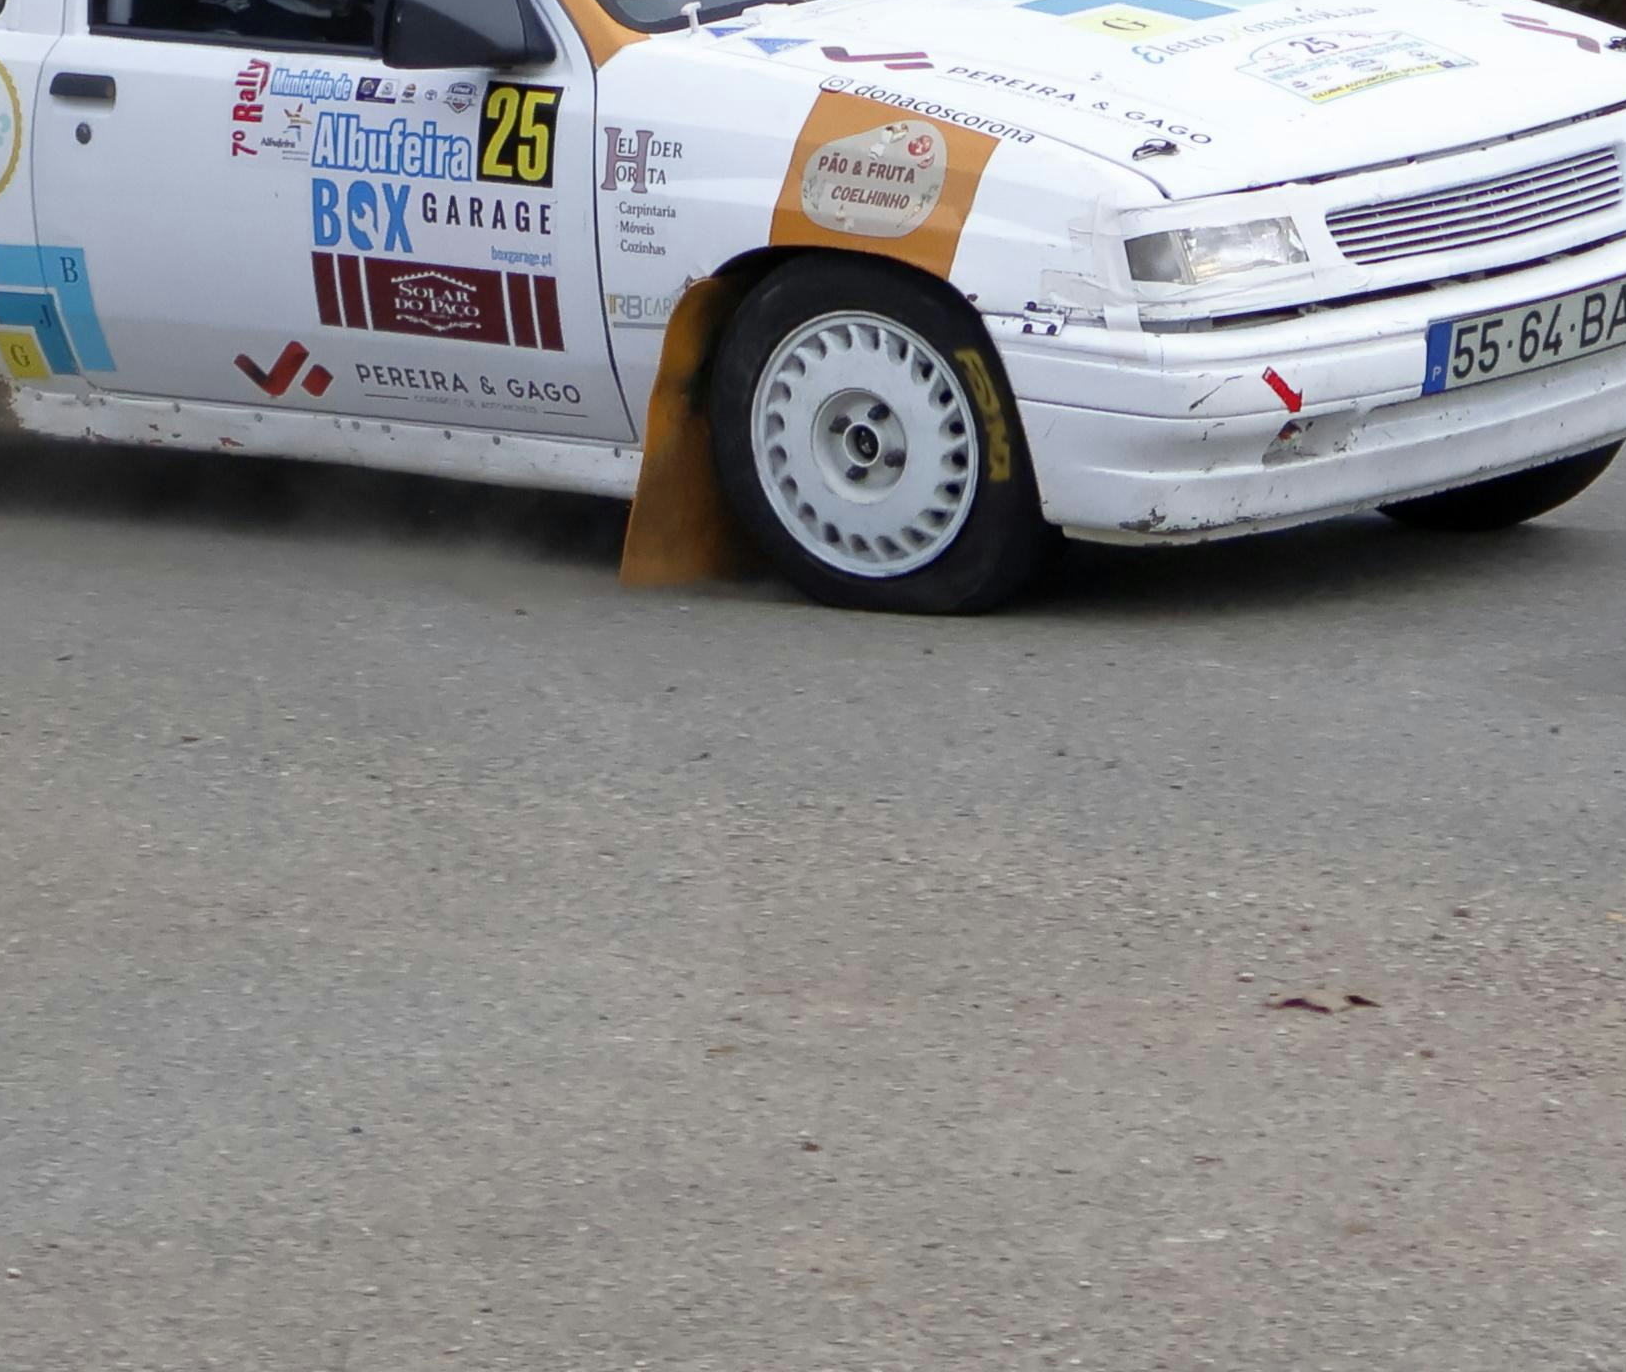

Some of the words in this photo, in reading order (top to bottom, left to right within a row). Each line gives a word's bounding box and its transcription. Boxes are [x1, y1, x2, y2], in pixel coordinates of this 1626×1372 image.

[1101, 16, 1152, 32] G
[1288, 36, 1340, 55] 25
[233, 58, 271, 123] Rally
[270, 67, 334, 105] Município
[334, 73, 353, 102] de
[854, 83, 1036, 145] donacoscorona
[947, 65, 1077, 103] PEREIRA
[1091, 100, 1110, 111] &
[1124, 110, 1213, 145] GAGO
[481, 86, 556, 182] 25
[311, 112, 472, 183] Albufeira
[818, 152, 848, 174] PÃO
[852, 160, 862, 176] &
[867, 162, 916, 184] FRUTA
[619, 200, 677, 218] Carpintaria
[831, 185, 910, 210] COELHINHO
[311, 177, 413, 254] BOX
[422, 191, 553, 235] GARAGE
[620, 219, 655, 236] Móveis
[620, 238, 666, 256] Cozinhas
[59, 255, 79, 284] B
[398, 282, 471, 304] SOLAR
[39, 304, 52, 328] J
[394, 297, 424, 311] DO
[430, 299, 481, 319] PAÇO
[10, 344, 31, 368] G
[355, 363, 469, 394] PEREIRA
[479, 375, 496, 396] &
[506, 377, 582, 405] GAGO
[1432, 365, 1442, 382] P
